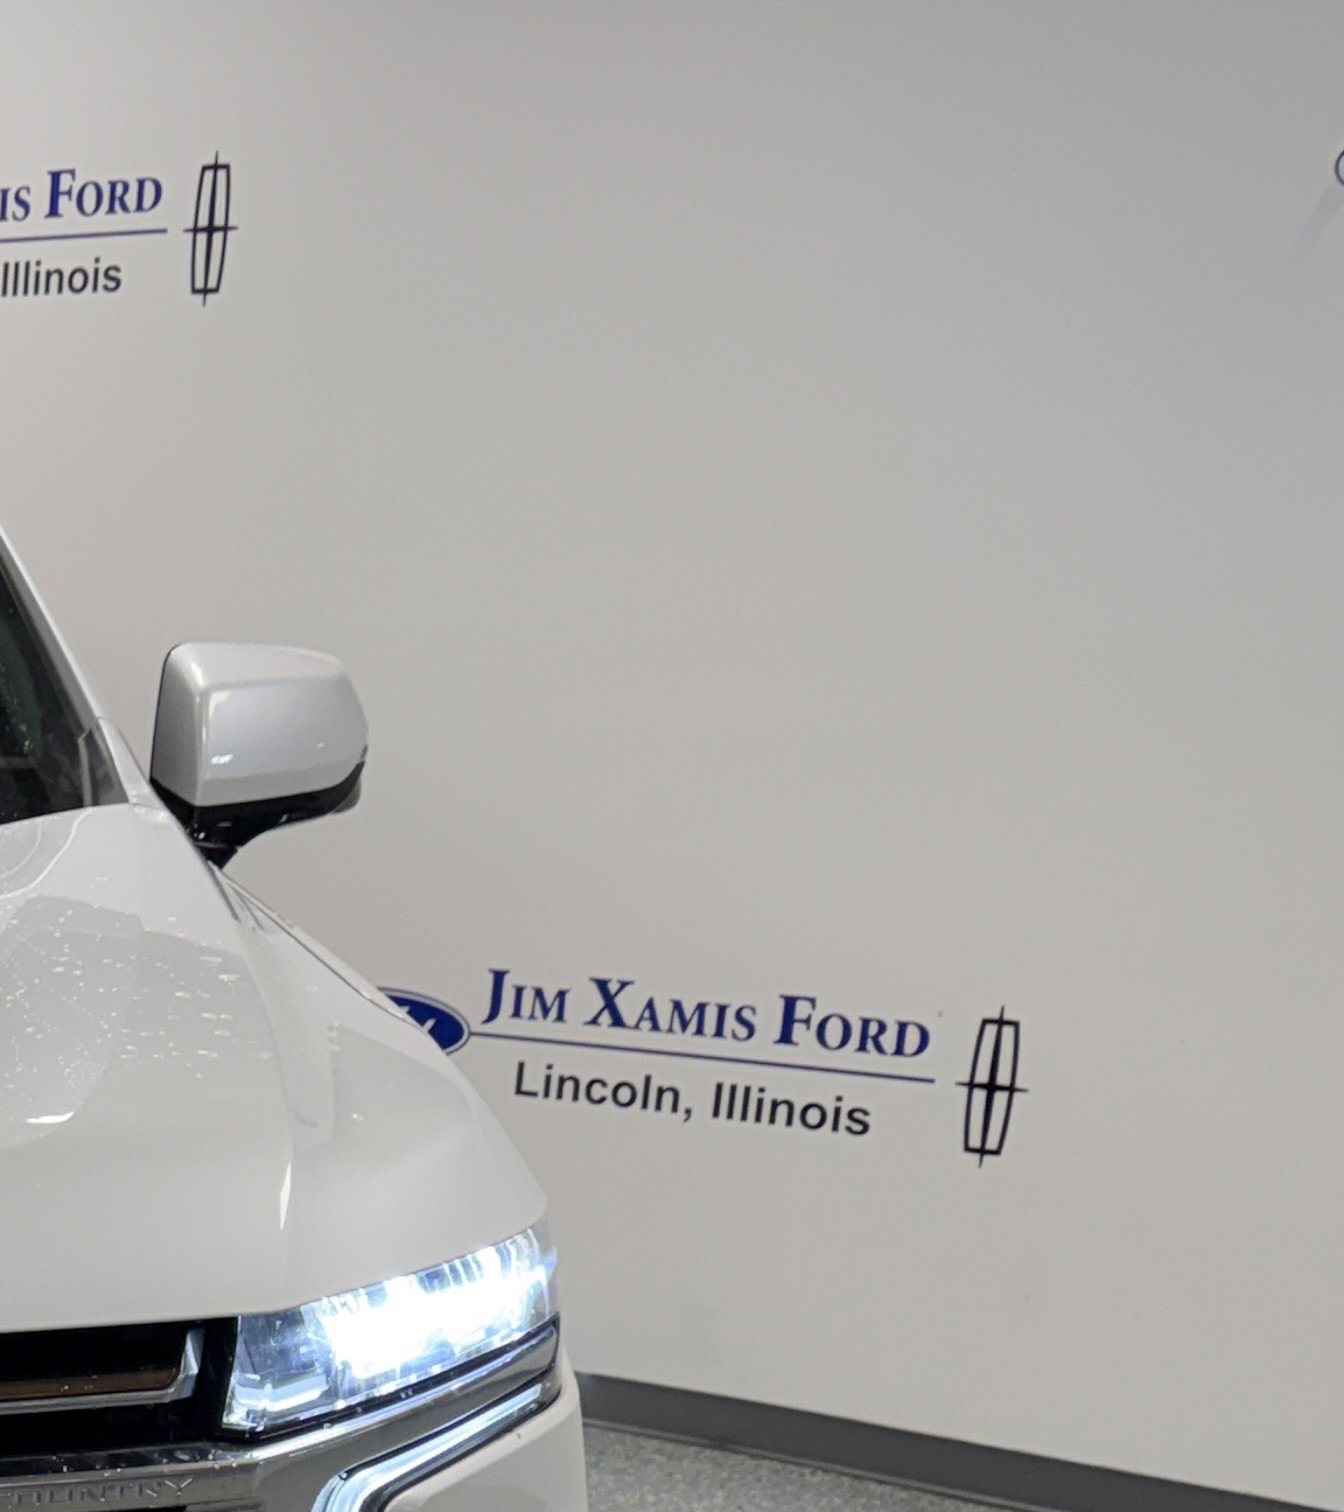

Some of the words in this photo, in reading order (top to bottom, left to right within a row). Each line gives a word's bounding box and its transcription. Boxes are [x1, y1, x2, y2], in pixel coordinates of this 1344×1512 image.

[44, 168, 164, 221] FORD
[0, 258, 123, 298] Illinois
[481, 968, 573, 1026] JIM
[585, 976, 758, 1043] XAMIS
[773, 993, 931, 1059] FORD
[514, 1060, 693, 1122] Lincoln,
[711, 1082, 872, 1137] Illinois
